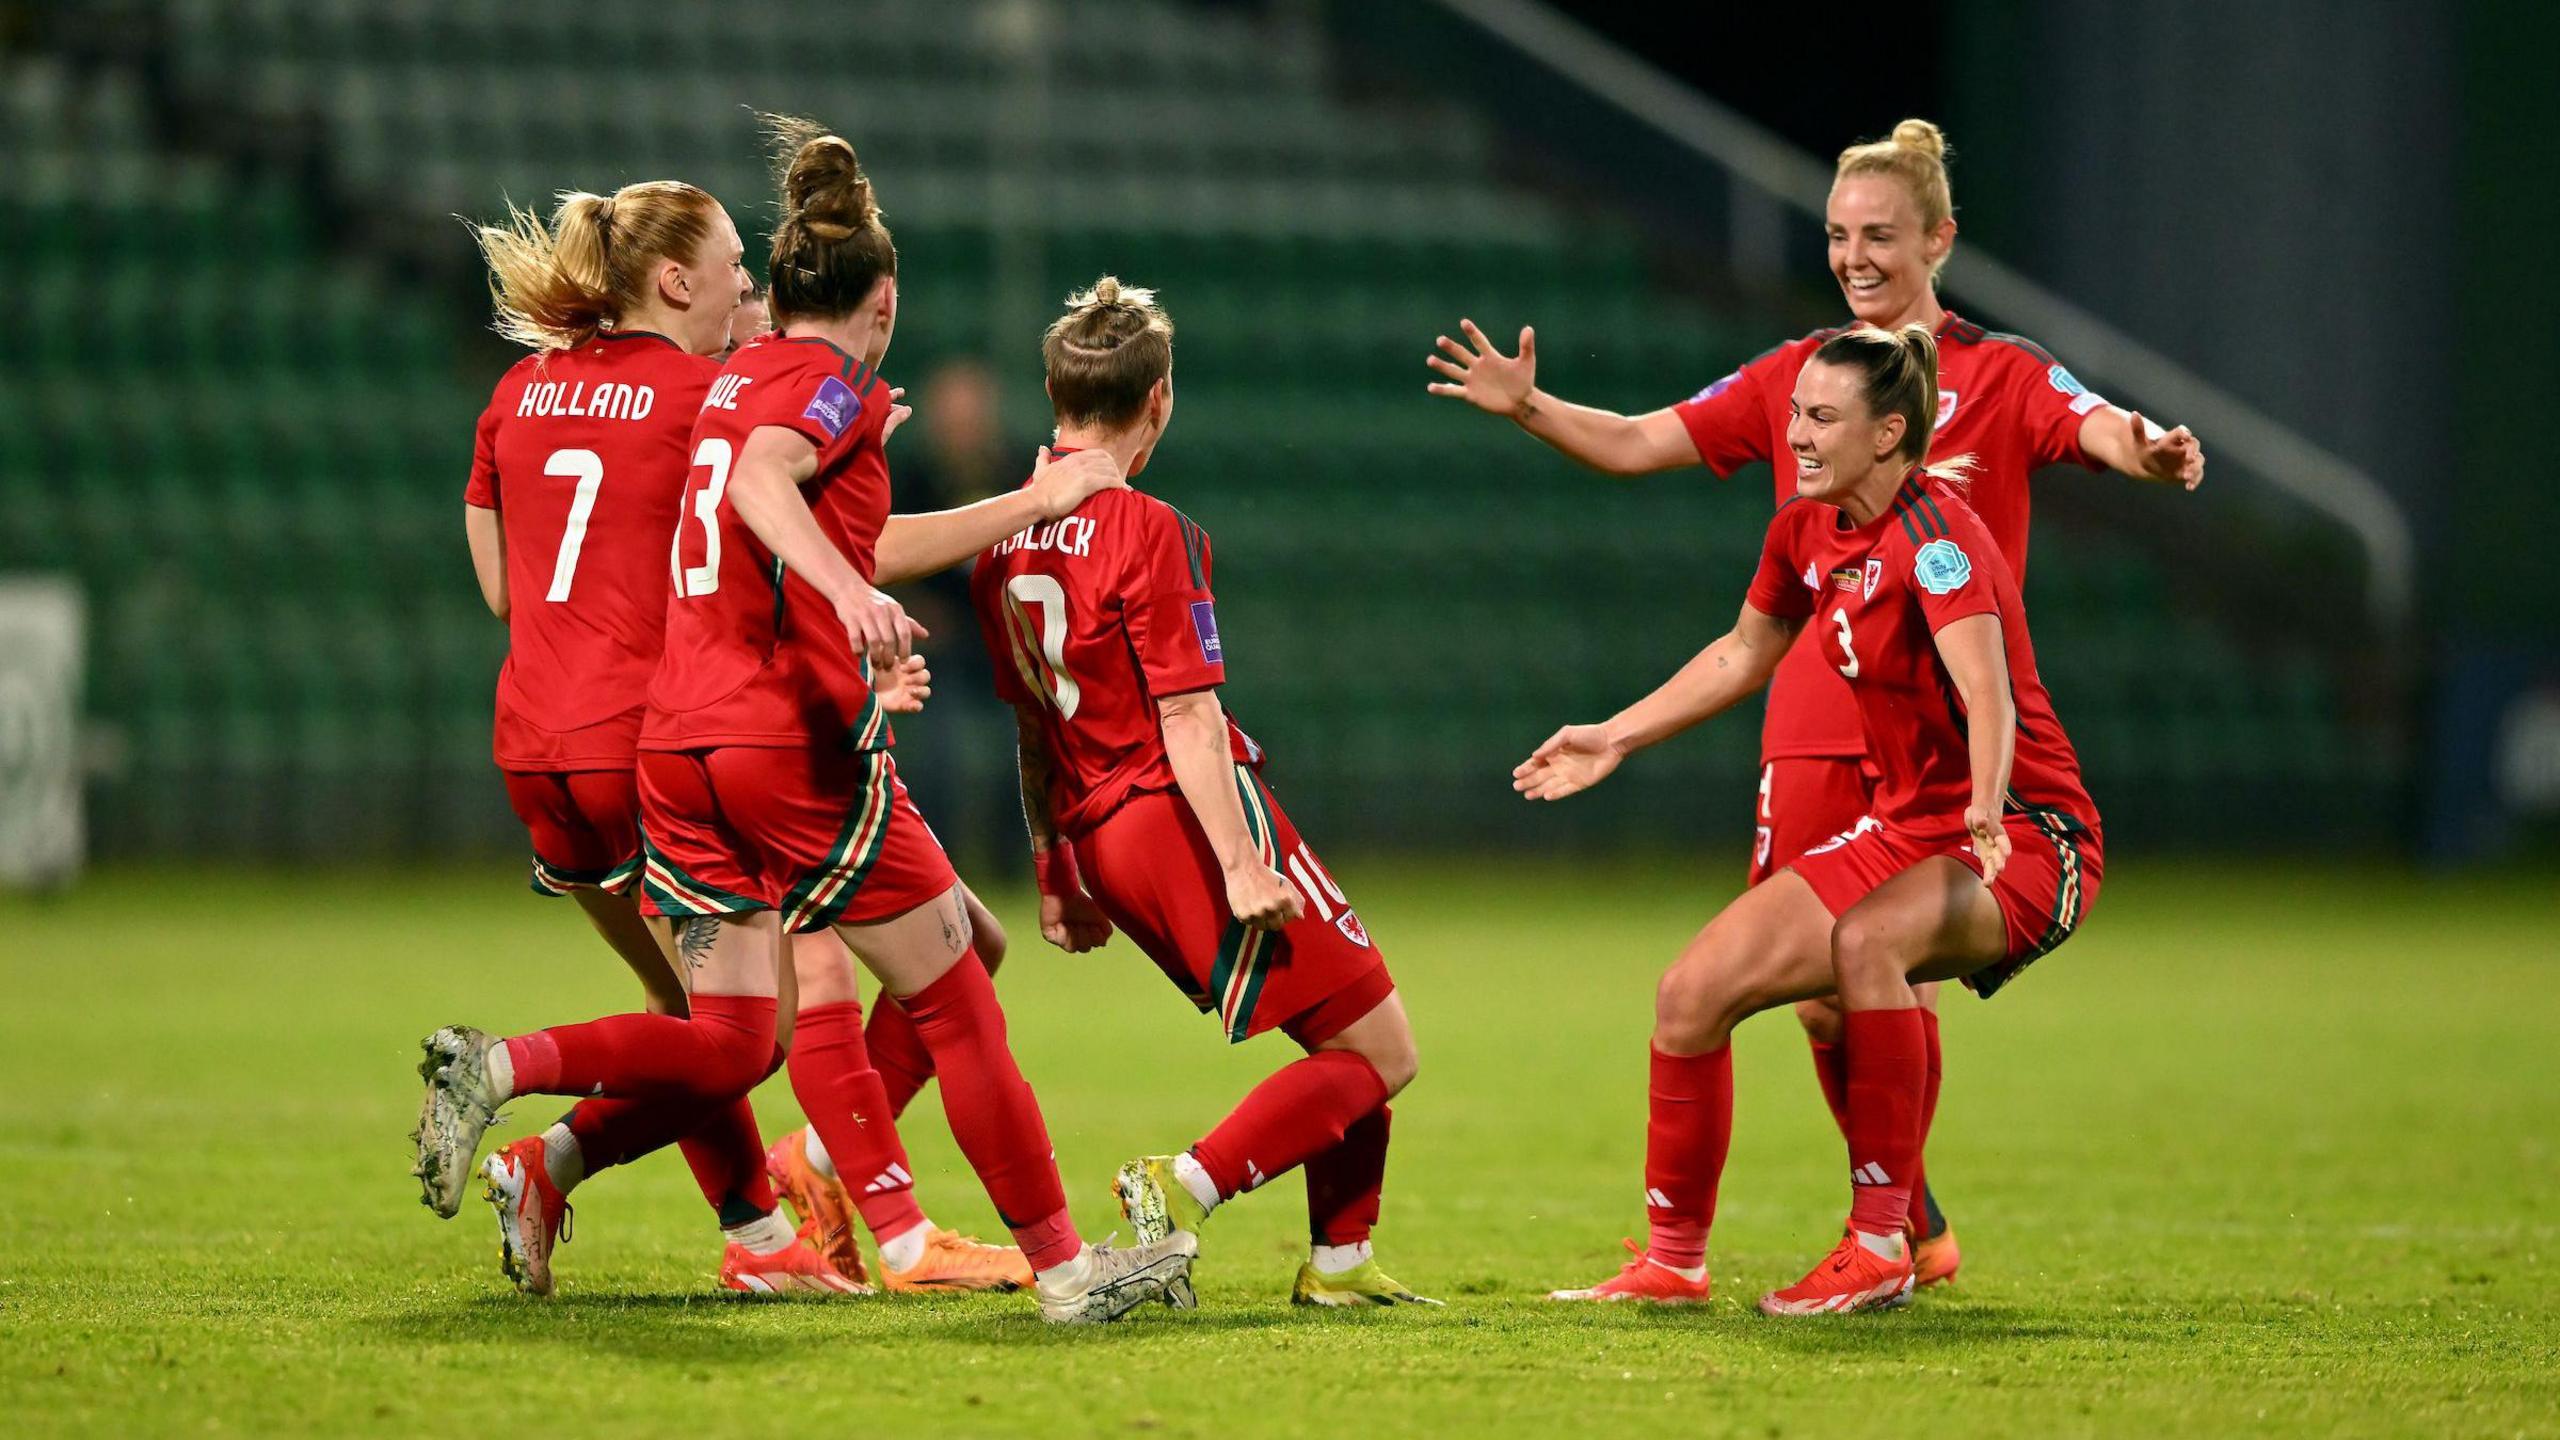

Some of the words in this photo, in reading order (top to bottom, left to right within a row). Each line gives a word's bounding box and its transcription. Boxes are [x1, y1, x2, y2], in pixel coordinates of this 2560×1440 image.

[516, 382, 655, 420] HOLLAND
[543, 448, 604, 603] 7
[671, 438, 732, 599] 13
[1001, 574, 1081, 722] 10
[1832, 608, 1859, 678] 3
